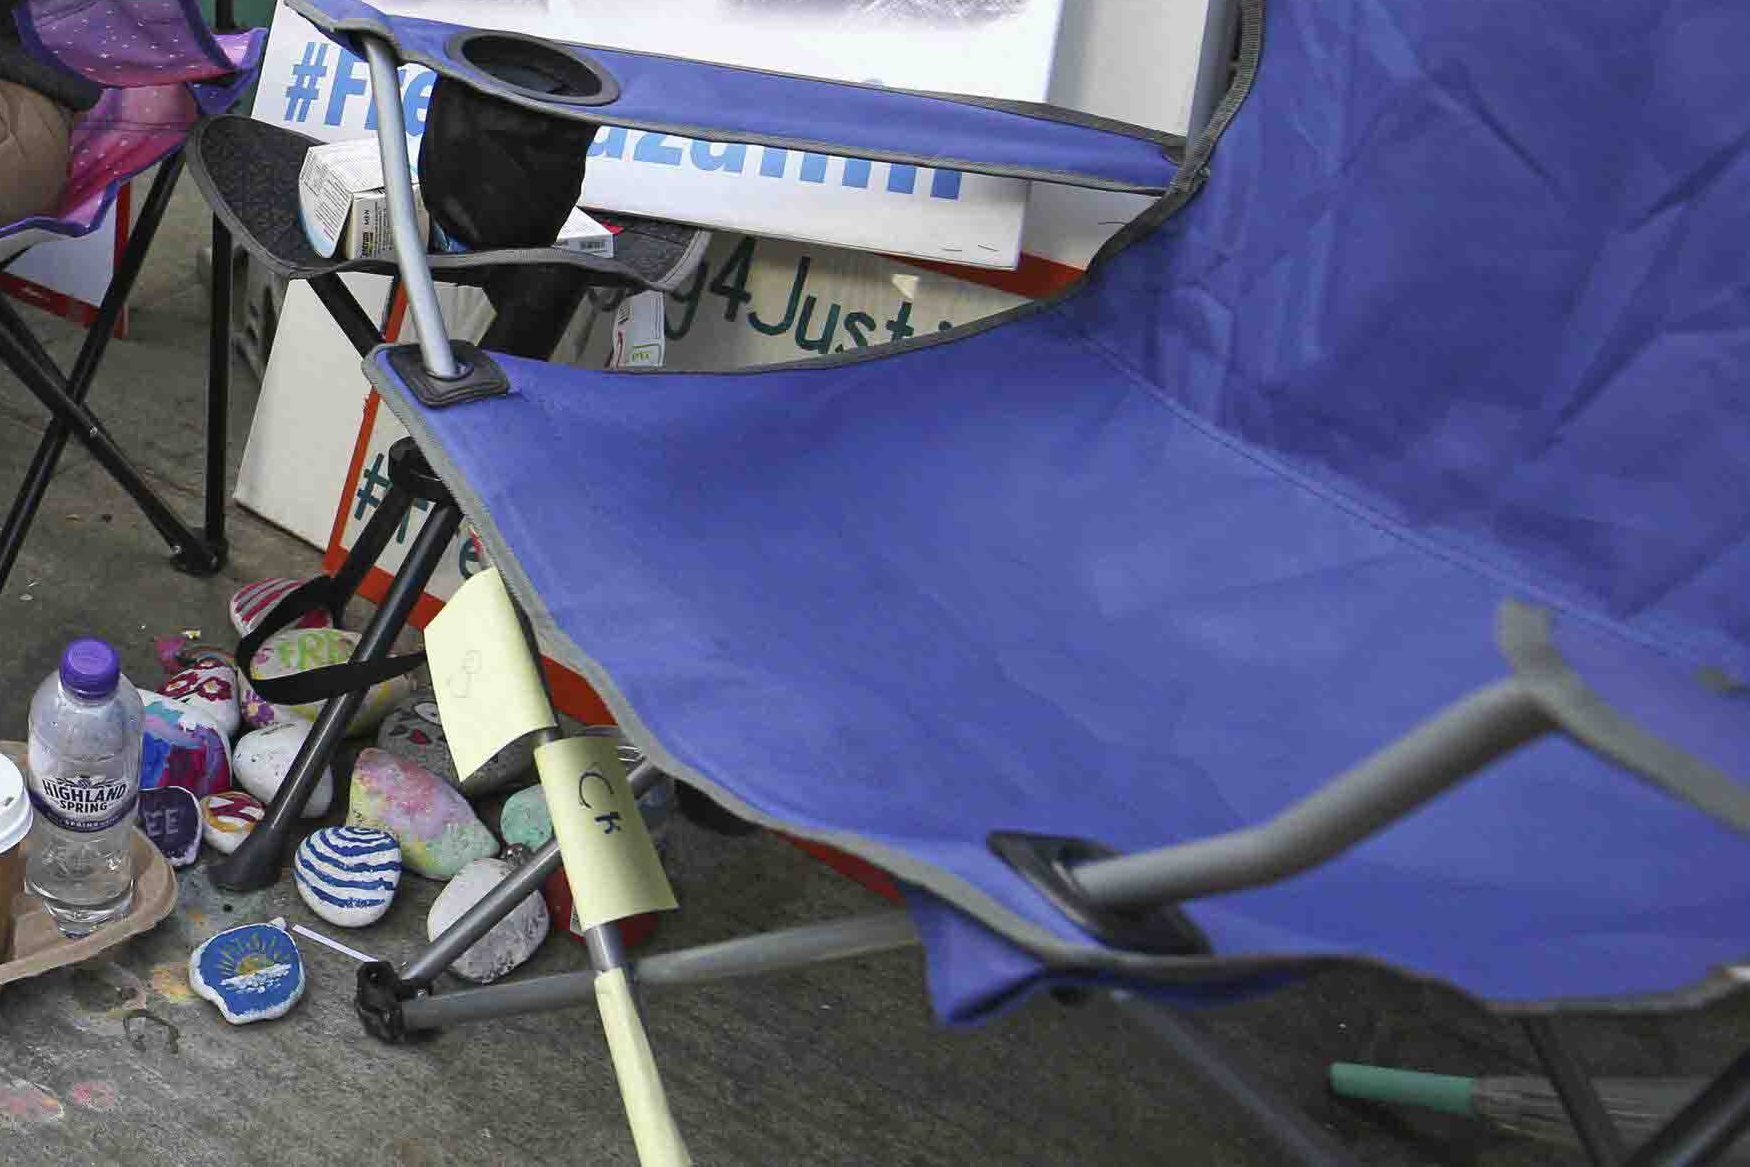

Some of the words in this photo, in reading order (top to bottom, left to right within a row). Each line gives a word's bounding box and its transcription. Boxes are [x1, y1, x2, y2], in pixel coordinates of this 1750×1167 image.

[664, 234, 953, 356] y4Just
[42, 778, 129, 803] HIGHLAND
[59, 799, 108, 813] SPRING
